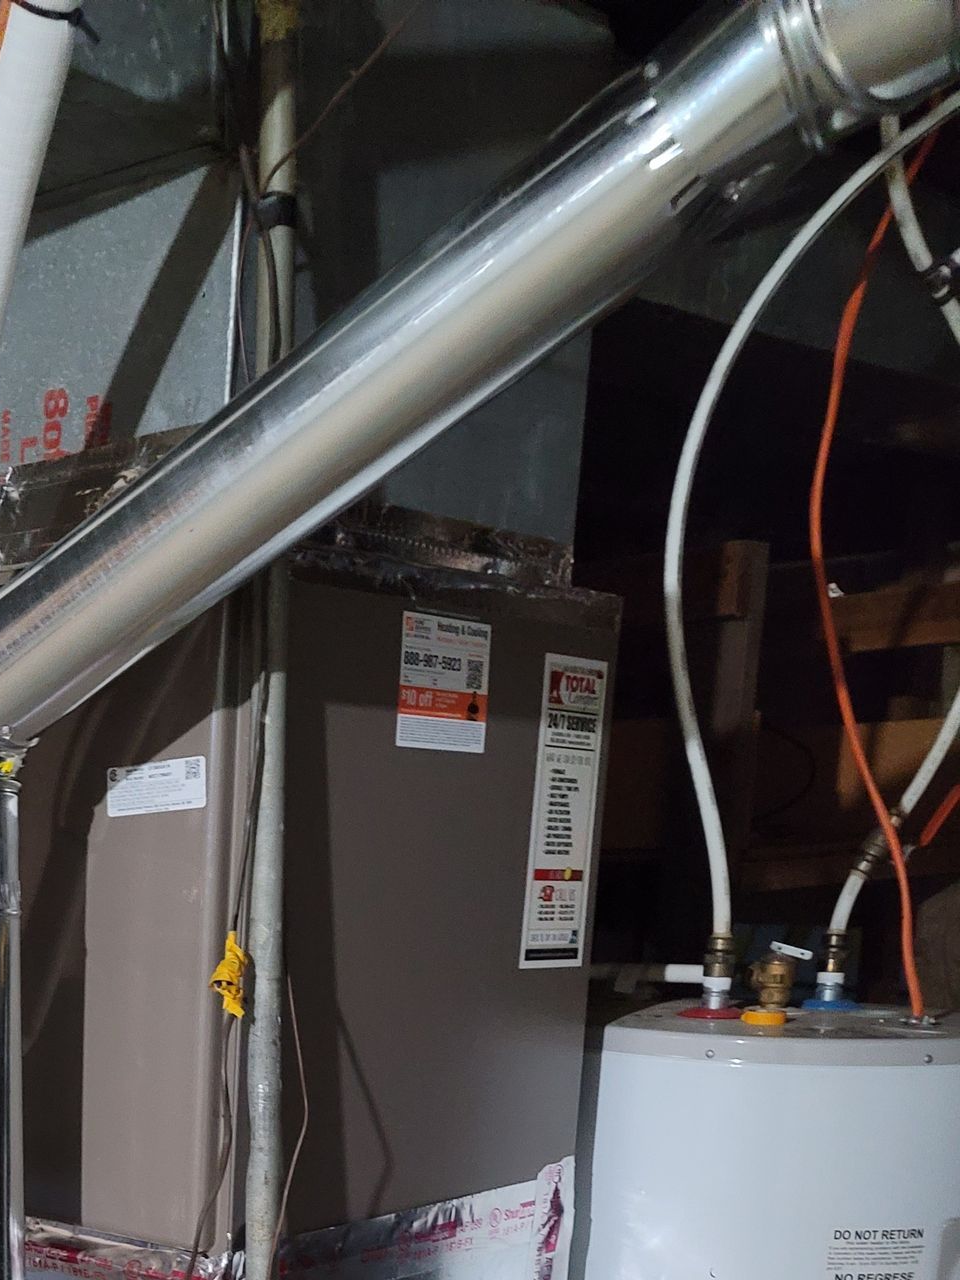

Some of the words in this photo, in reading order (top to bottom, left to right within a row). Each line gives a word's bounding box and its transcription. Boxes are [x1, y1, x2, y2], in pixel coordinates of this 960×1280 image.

[566, 674, 597, 695] TOTAL
[419, 690, 433, 708] off
[548, 711, 566, 730] 24/7
[566, 715, 597, 734] SERVICE
[834, 1230, 851, 1240] DO
[854, 1230, 878, 1240] NOT
[881, 1228, 924, 1240] RETURN
